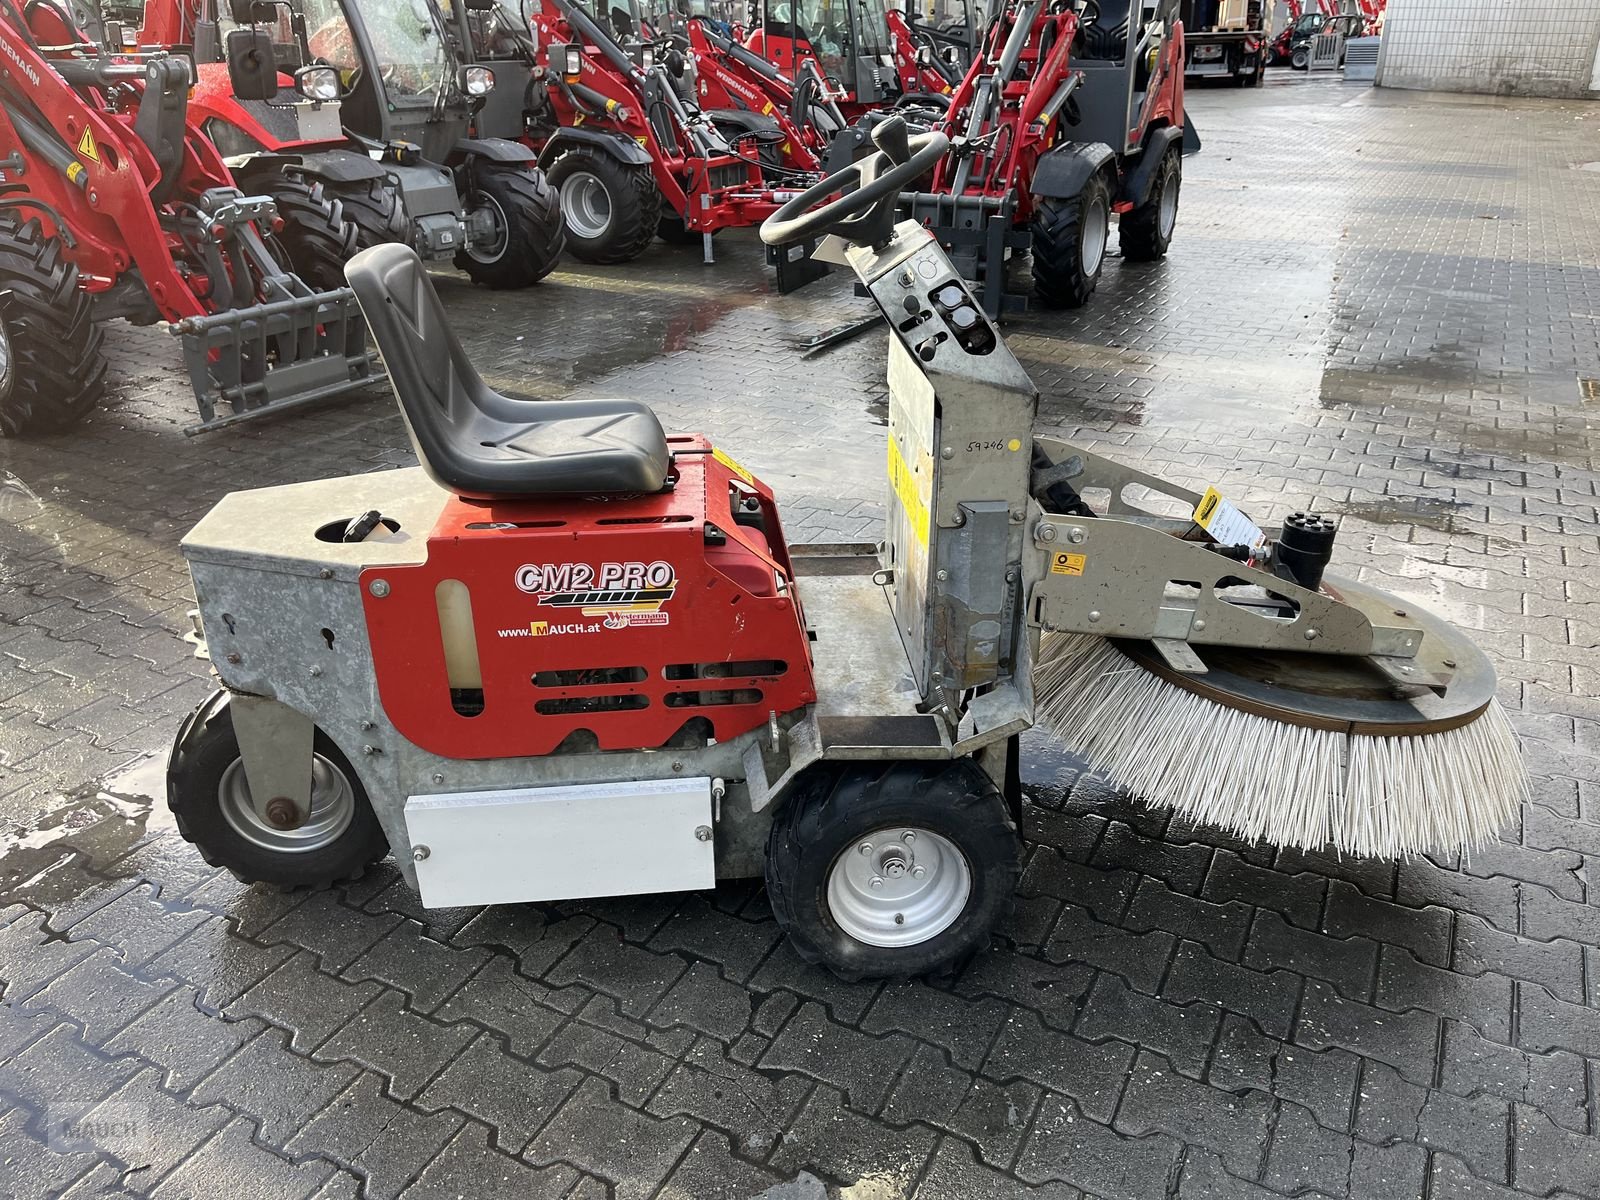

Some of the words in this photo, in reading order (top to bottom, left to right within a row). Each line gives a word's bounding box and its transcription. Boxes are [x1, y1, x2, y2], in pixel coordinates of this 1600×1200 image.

[716, 69, 755, 100] WEIDEMANN
[515, 563, 594, 593] CM2
[600, 561, 674, 590] PRO
[607, 611, 667, 622] Westermann
[498, 622, 600, 637] www.MAUCH.at
